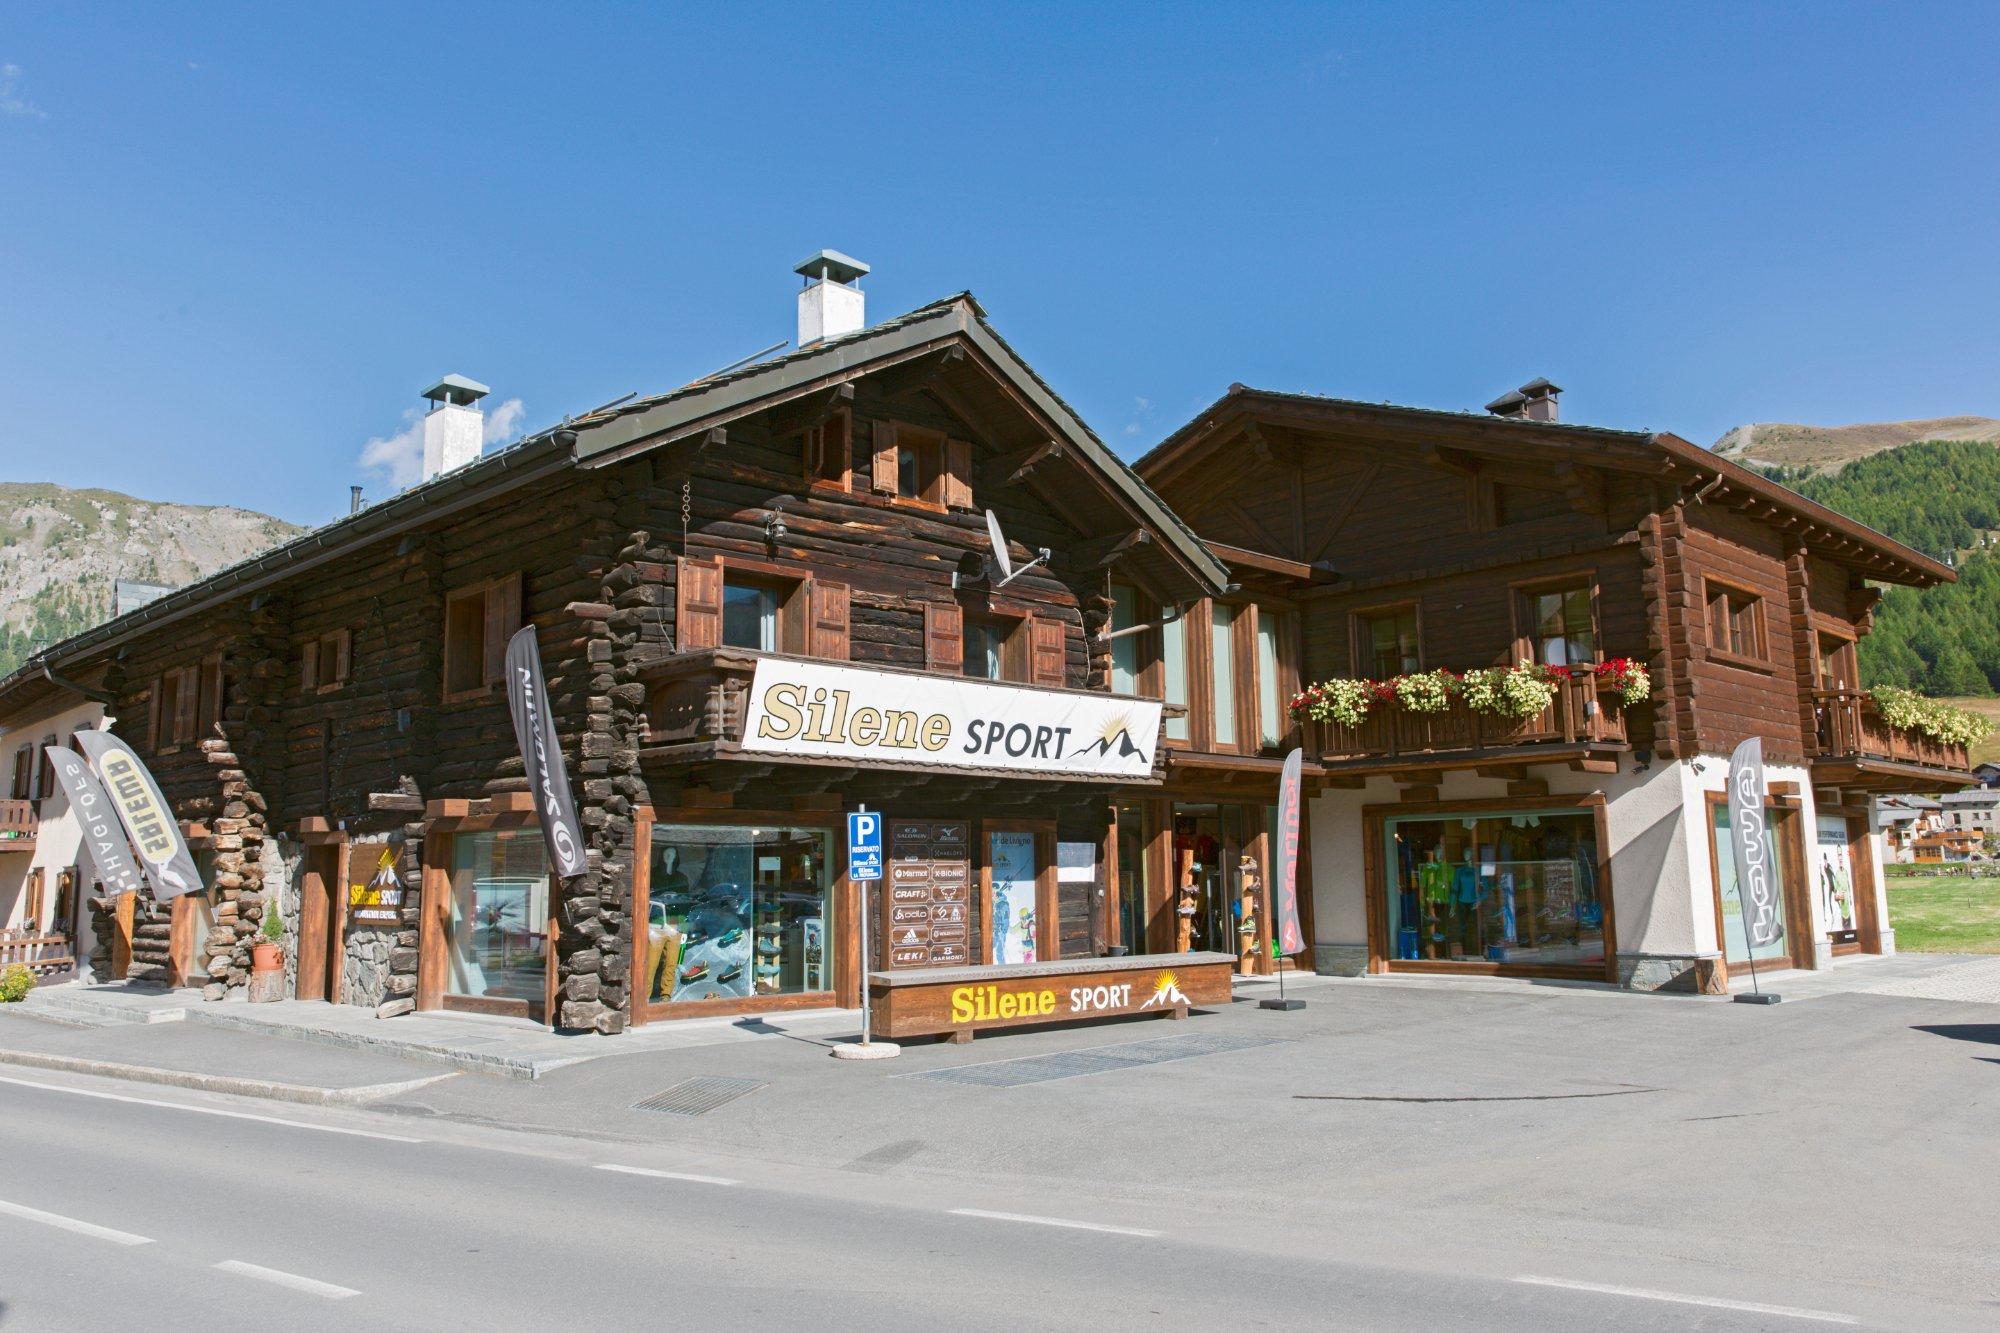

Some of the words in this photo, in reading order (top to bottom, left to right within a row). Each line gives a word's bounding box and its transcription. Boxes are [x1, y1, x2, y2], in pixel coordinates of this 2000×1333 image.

[757, 682, 951, 752] Silene
[963, 718, 1072, 759] SPORT
[517, 667, 561, 816] SALOMON
[857, 816, 875, 845] P
[895, 890, 921, 898] CRAFT
[897, 952, 923, 960] LEKI
[952, 985, 1056, 1024] Silene
[1070, 984, 1131, 1012] SPORT
